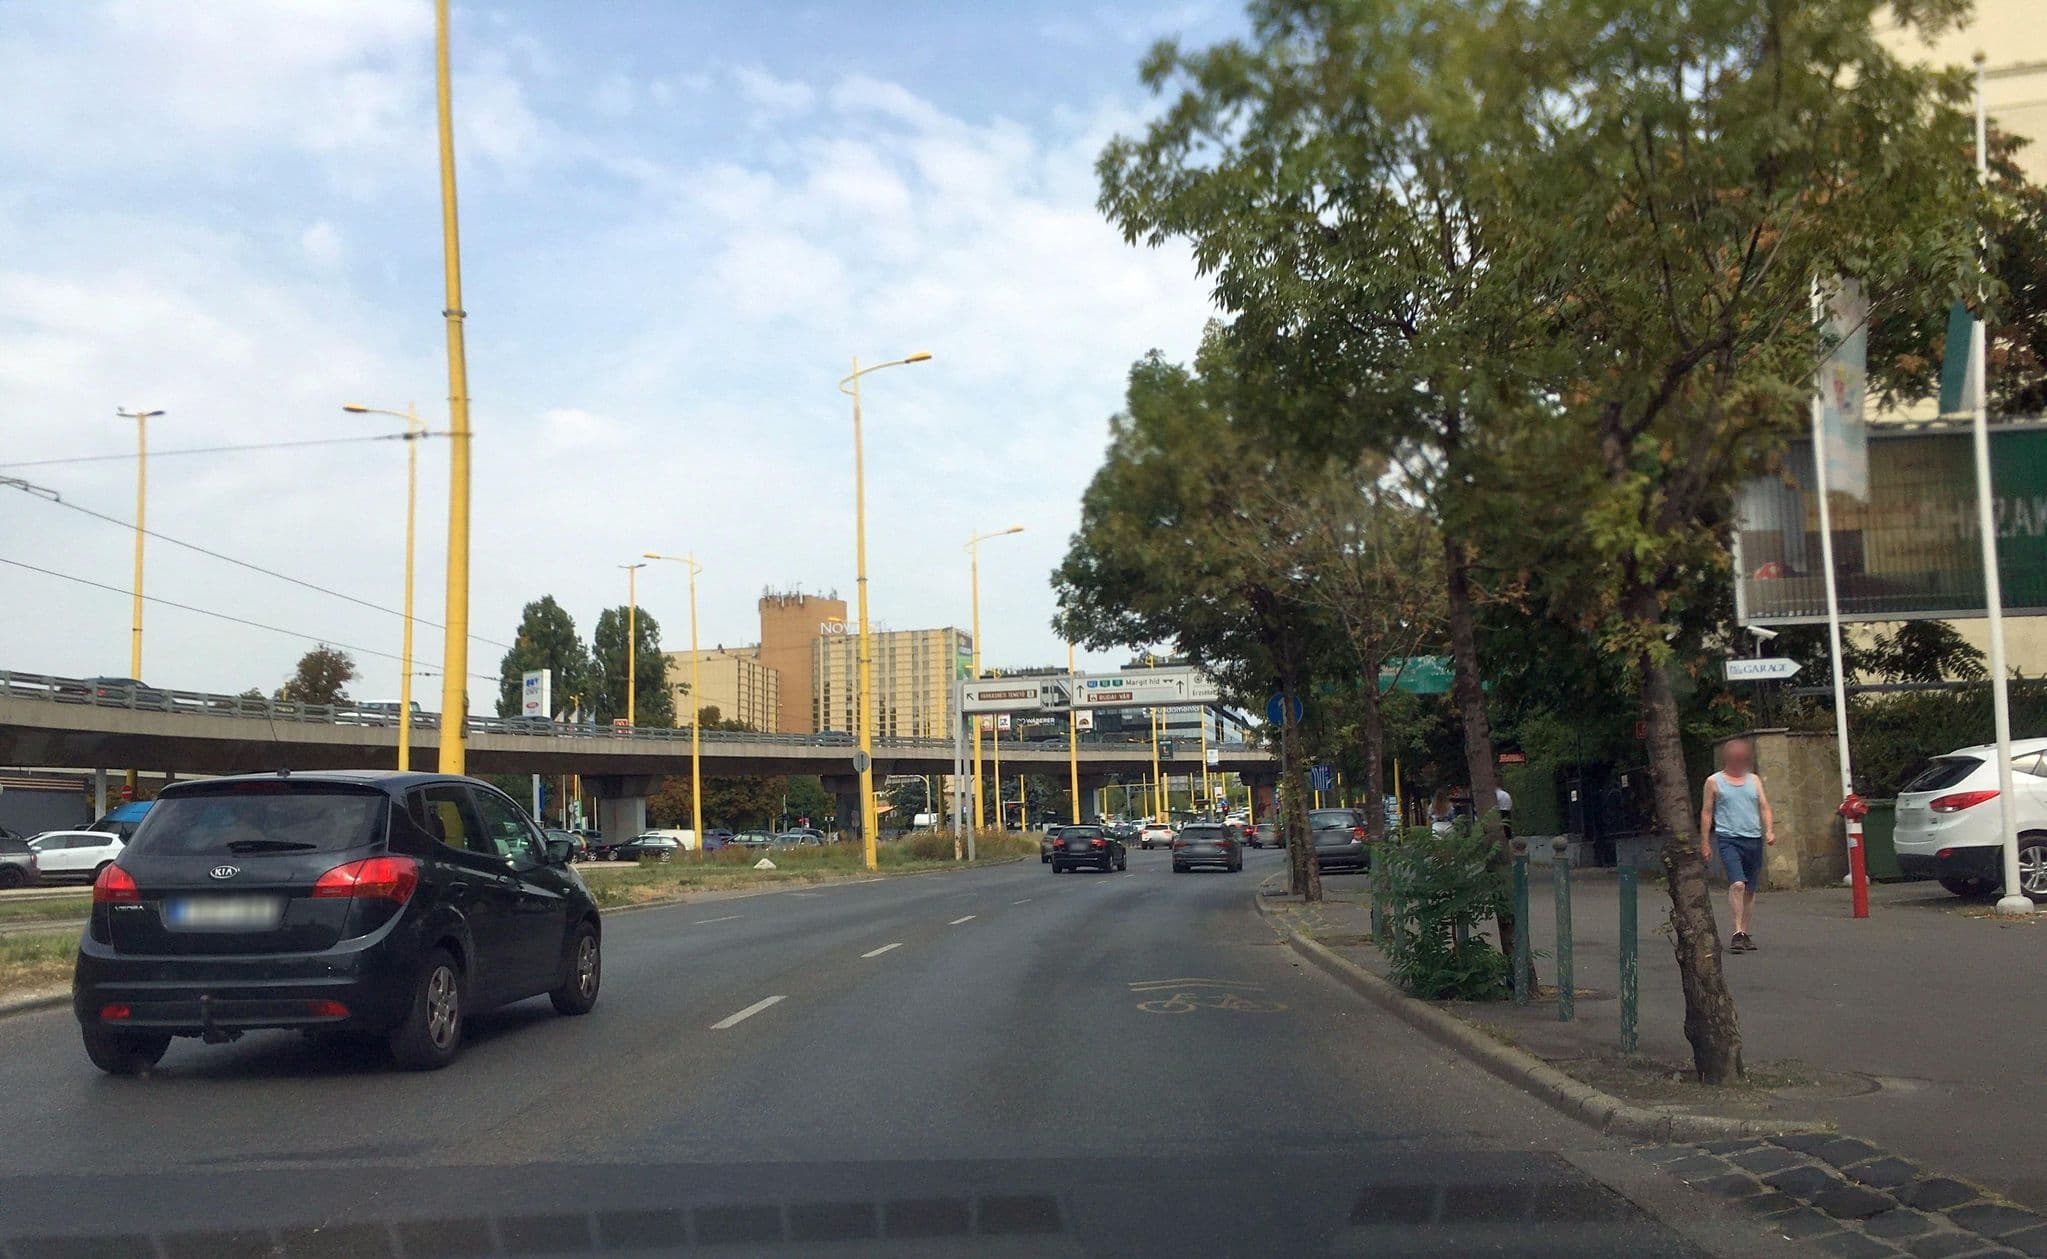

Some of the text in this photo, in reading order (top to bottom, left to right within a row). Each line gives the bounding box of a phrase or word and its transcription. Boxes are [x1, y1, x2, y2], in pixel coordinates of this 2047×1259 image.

[1743, 663, 1787, 673] GARAGE
[1125, 679, 1148, 687] Margit
[213, 867, 234, 877] KIA
